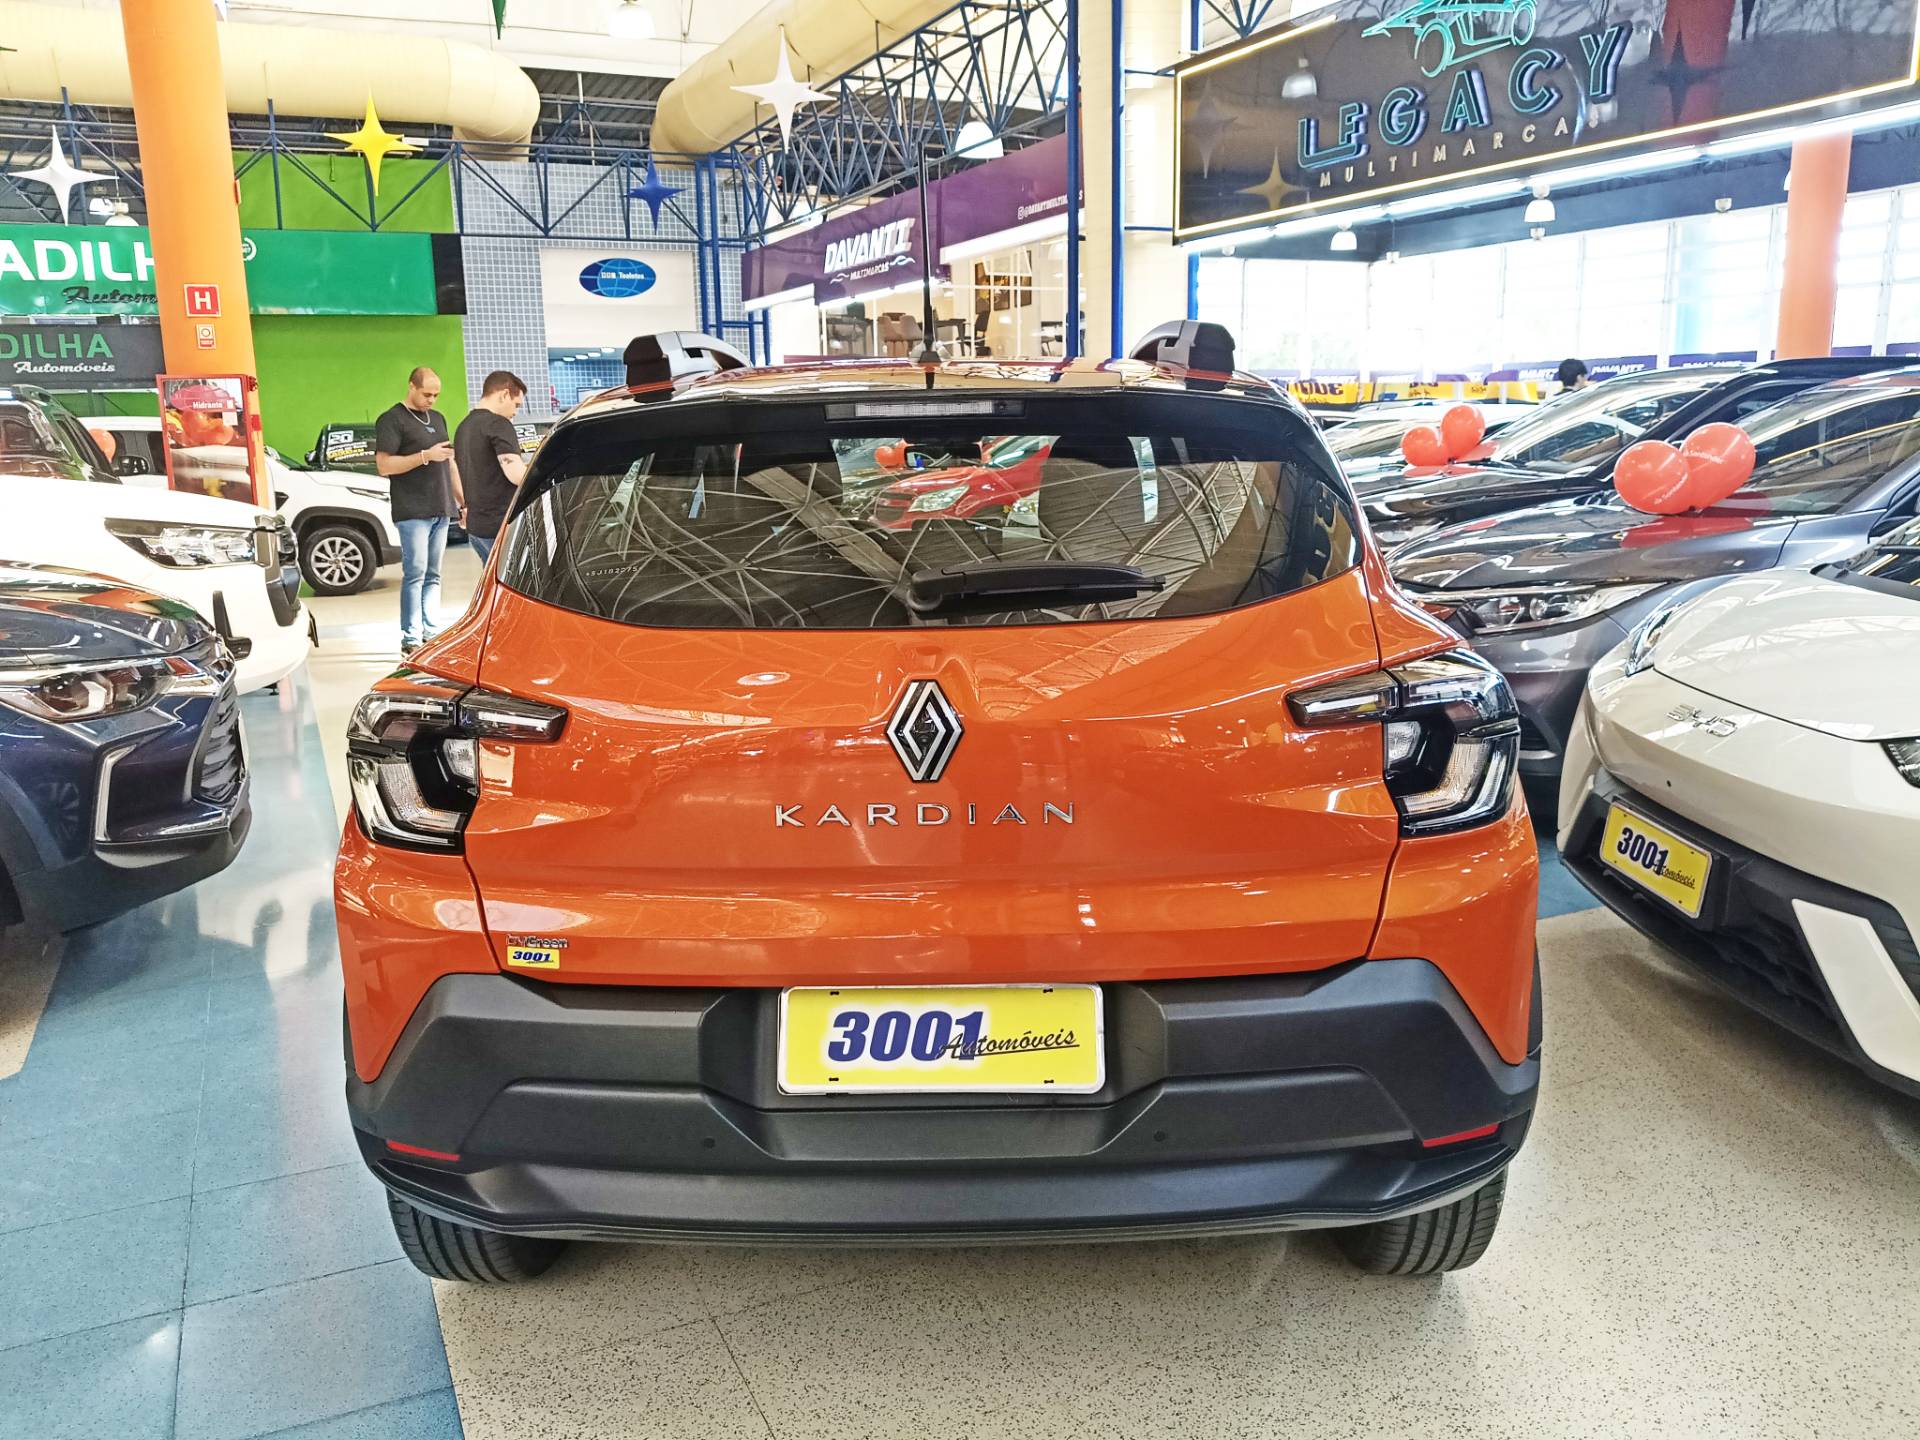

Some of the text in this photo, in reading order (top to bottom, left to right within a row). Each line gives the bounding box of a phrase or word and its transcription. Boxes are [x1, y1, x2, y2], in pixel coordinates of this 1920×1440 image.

[1298, 20, 1633, 169] LEGACY
[1319, 114, 1600, 188] MULTIMARCAS
[824, 217, 916, 274] DAVANTI
[849, 261, 890, 281] MULTIMARCAS
[194, 291, 212, 310] H
[13, 361, 115, 374] Automóveis
[192, 400, 223, 410] Hidrante
[775, 802, 1075, 827] KARDIAN
[1616, 826, 1669, 876] 3001
[512, 951, 551, 962] 3001
[827, 1011, 1080, 1062] 3001 Automóveis
